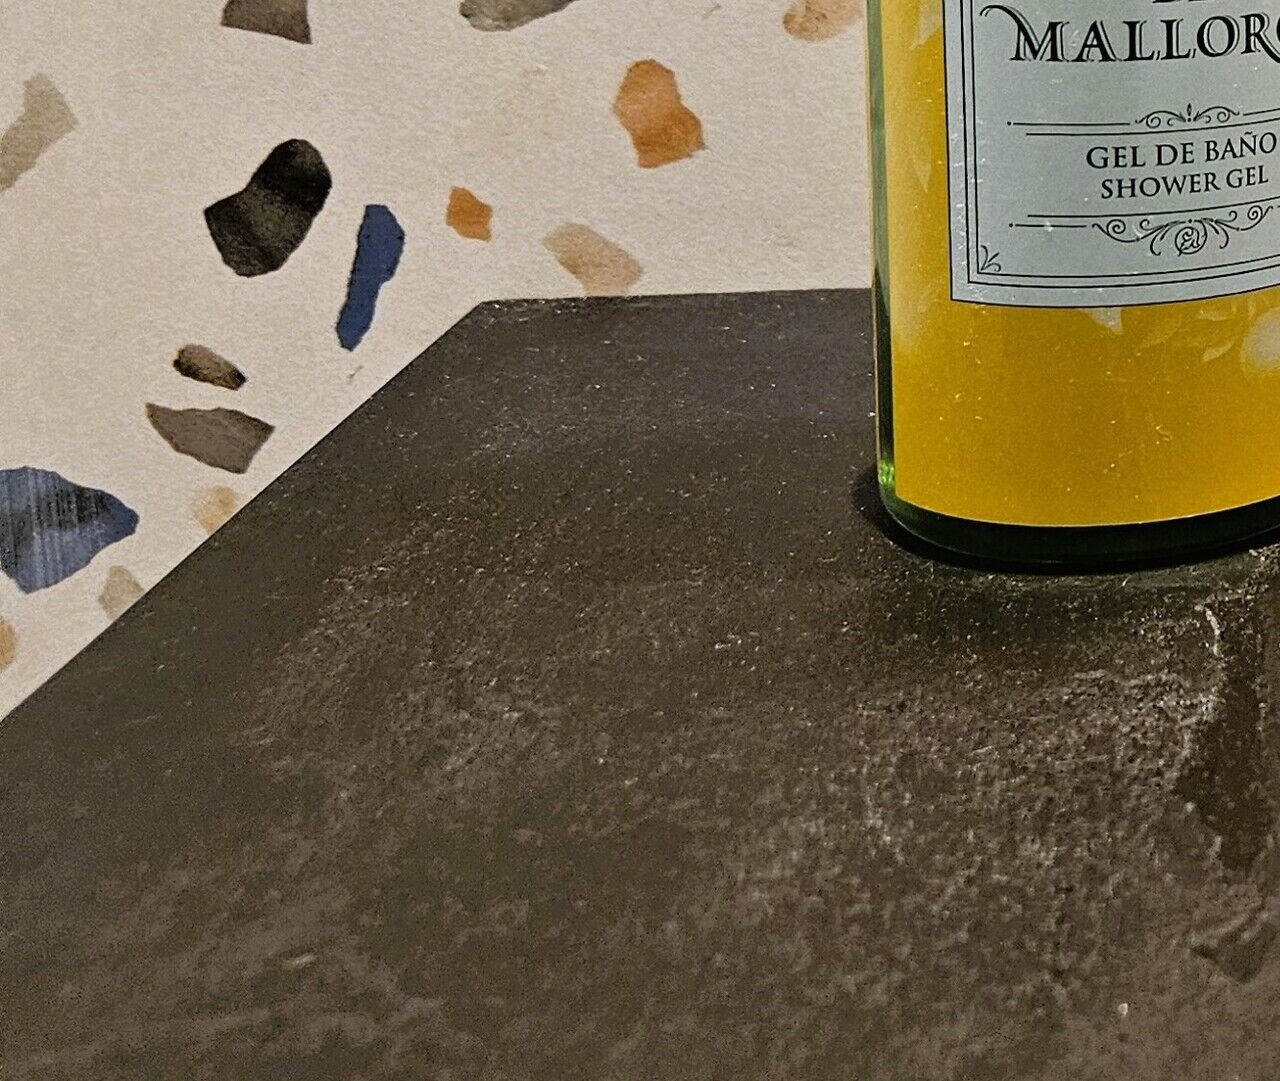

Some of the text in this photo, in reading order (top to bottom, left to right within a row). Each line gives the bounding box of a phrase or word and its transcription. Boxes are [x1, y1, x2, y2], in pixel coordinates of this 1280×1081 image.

[1086, 131, 1278, 170] GEL DE BAÑO
[1100, 164, 1270, 200] SHOWER GEL
